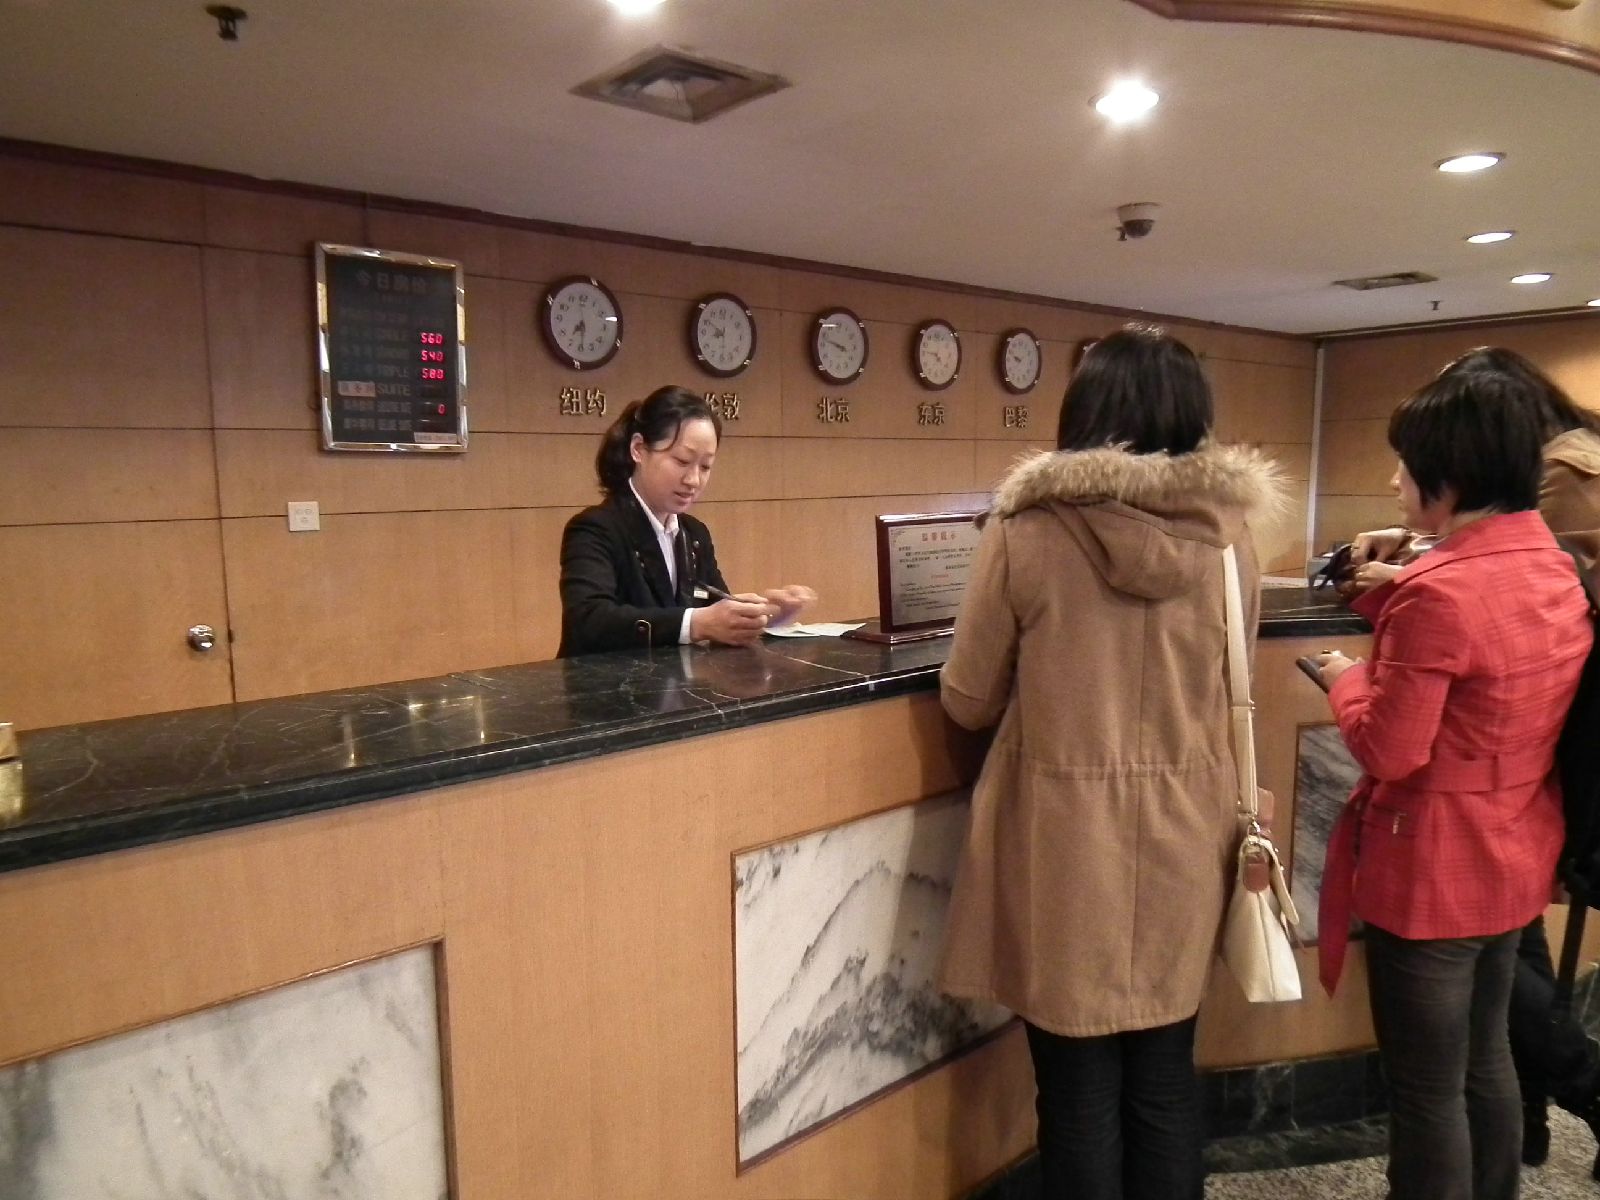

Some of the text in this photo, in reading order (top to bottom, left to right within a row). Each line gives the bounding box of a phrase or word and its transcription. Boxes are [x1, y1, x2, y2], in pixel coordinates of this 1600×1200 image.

[421, 332, 443, 344] 560
[421, 350, 444, 362] 540
[422, 368, 445, 380] 580
[378, 383, 412, 396] SUITE
[560, 387, 607, 417] 纽约
[817, 397, 850, 423] 北京
[918, 402, 945, 425] 东京
[1004, 406, 1029, 428] 巴黎
